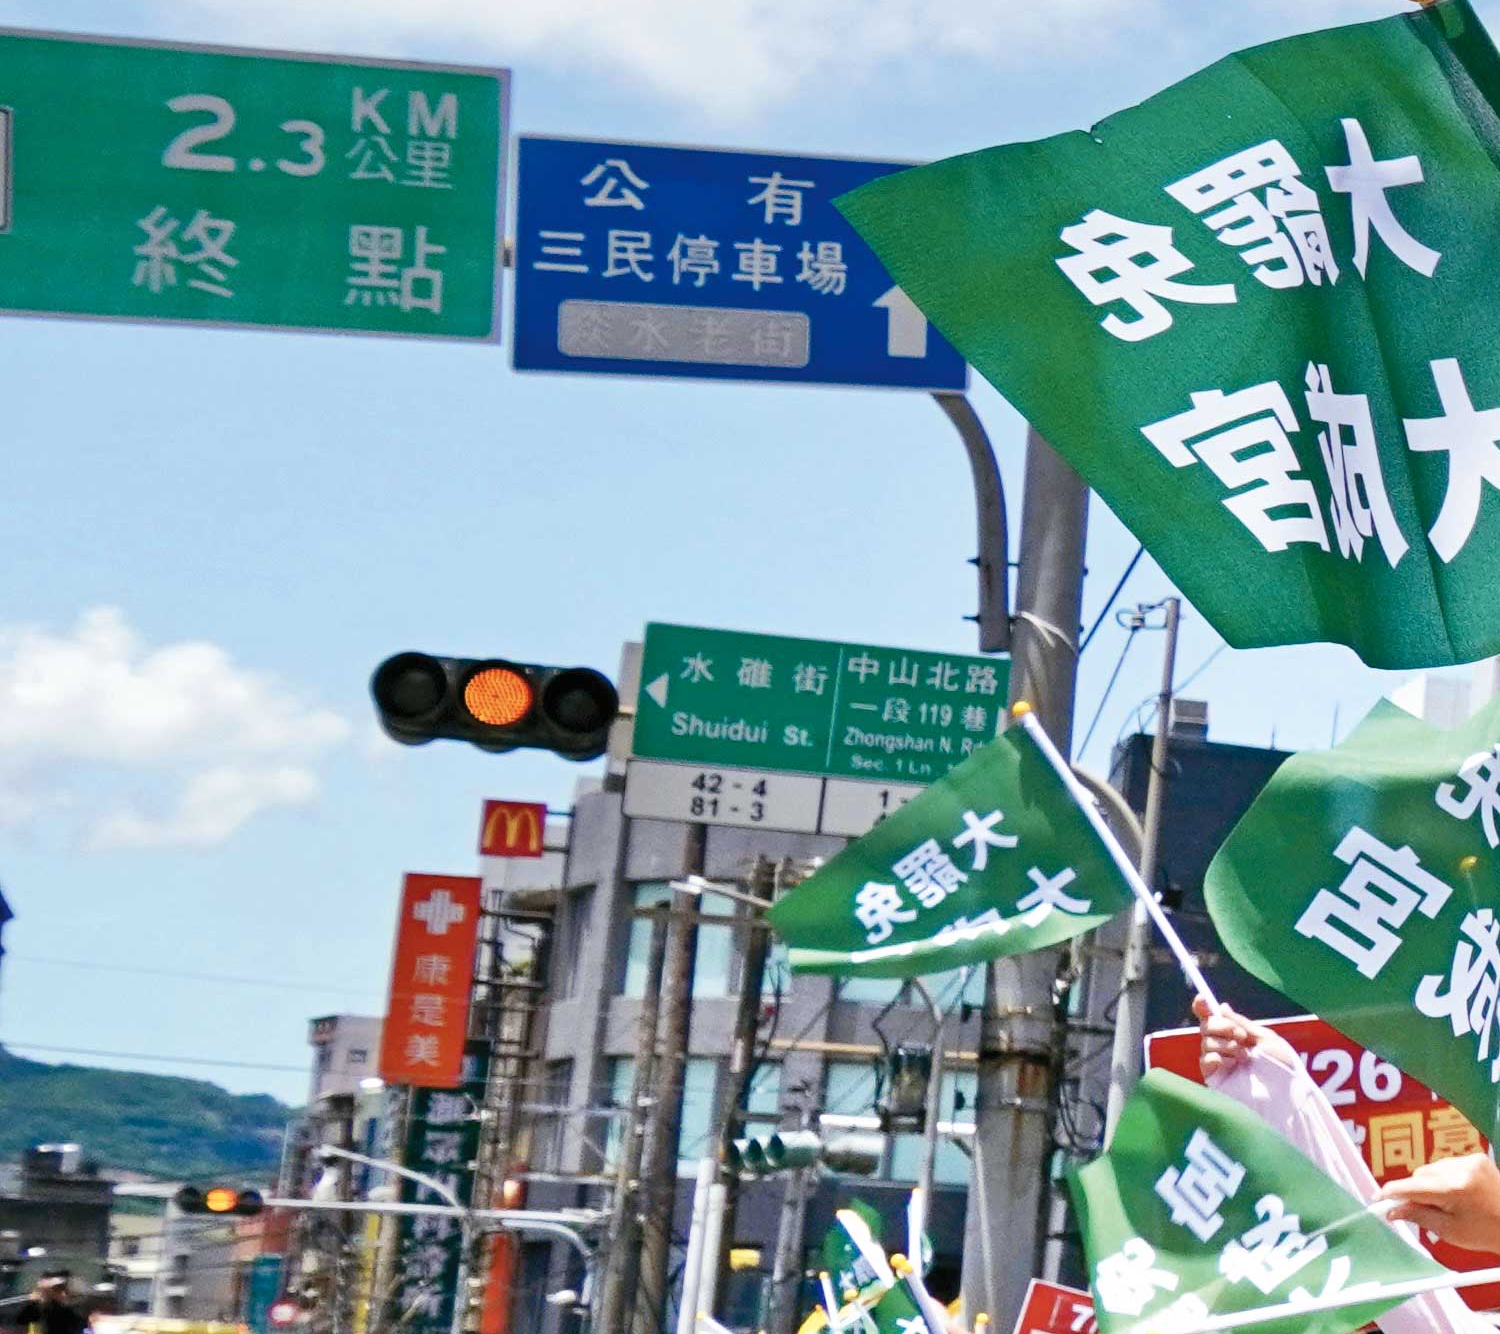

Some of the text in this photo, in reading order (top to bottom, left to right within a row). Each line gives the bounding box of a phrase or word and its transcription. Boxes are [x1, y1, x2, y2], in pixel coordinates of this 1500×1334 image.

[162, 86, 459, 177] 2.3 KM
[345, 135, 453, 189] 公里
[581, 158, 815, 227] 公有
[133, 205, 447, 314] 終點
[533, 229, 849, 295] 三民停車場
[847, 651, 999, 696] 中山北路
[671, 712, 768, 744] Shuidui
[843, 726, 935, 753] Zhongshan
[690, 797, 719, 817] 81
[692, 773, 722, 795] 42
[404, 953, 452, 1068] 康是美
